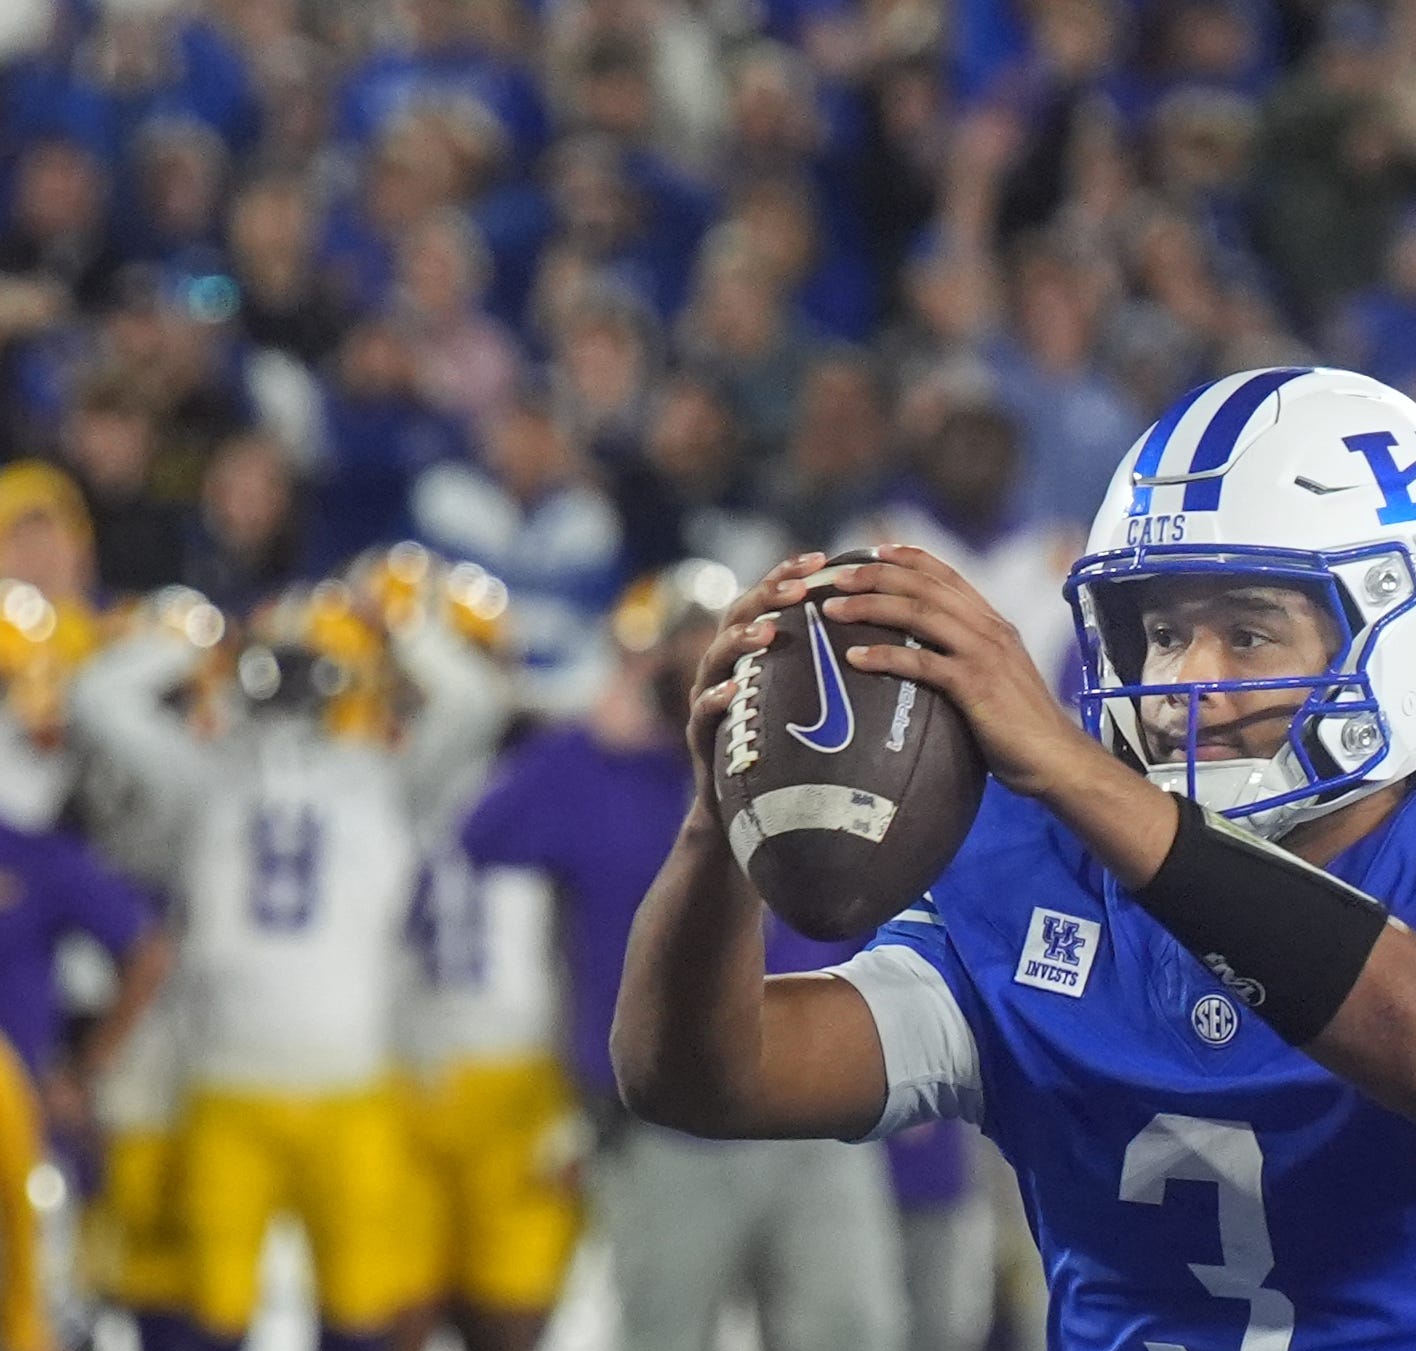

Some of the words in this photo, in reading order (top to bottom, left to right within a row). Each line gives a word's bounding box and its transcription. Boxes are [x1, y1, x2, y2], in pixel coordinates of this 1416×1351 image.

[1127, 514, 1186, 545] CATS
[1042, 915, 1086, 966] UK
[1024, 960, 1080, 987] INVESTS
[1196, 998, 1234, 1041] SEC
